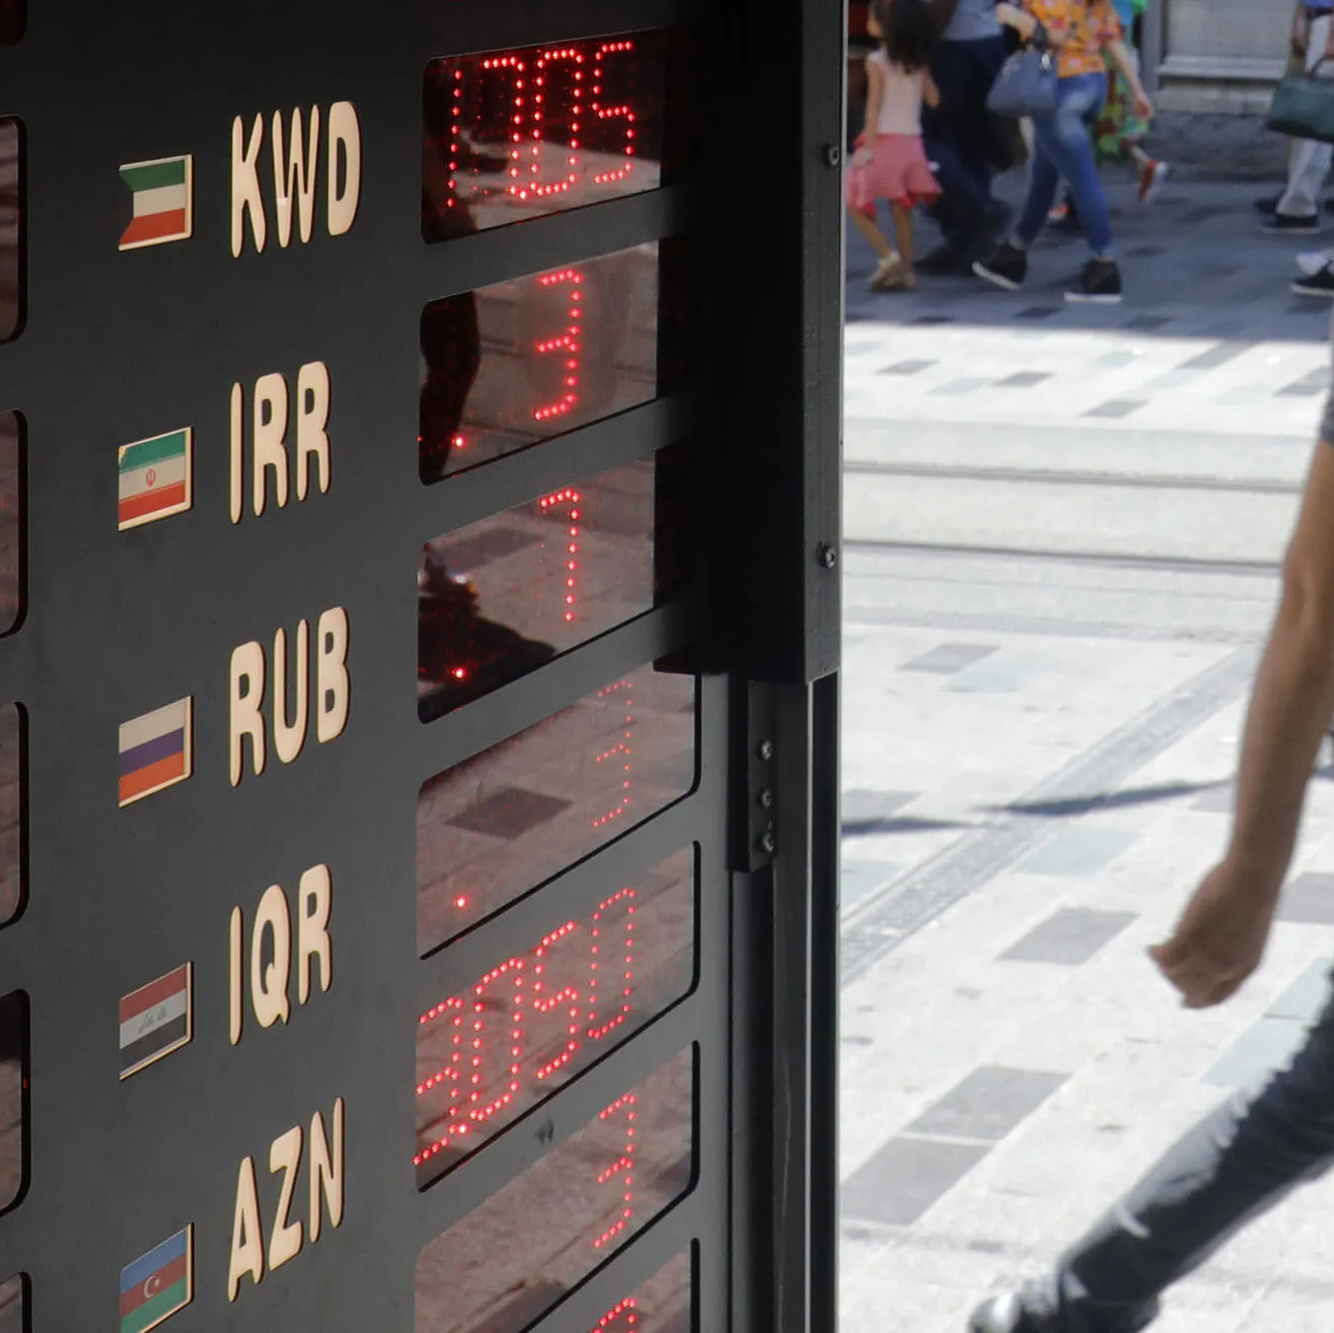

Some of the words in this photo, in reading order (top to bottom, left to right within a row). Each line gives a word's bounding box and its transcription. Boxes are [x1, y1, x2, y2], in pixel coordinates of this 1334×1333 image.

[231, 100, 361, 259] KWD
[229, 360, 331, 524] IRR
[229, 605, 350, 787] RUB
[229, 863, 333, 1046] IQR
[227, 1096, 348, 1303] AZN
